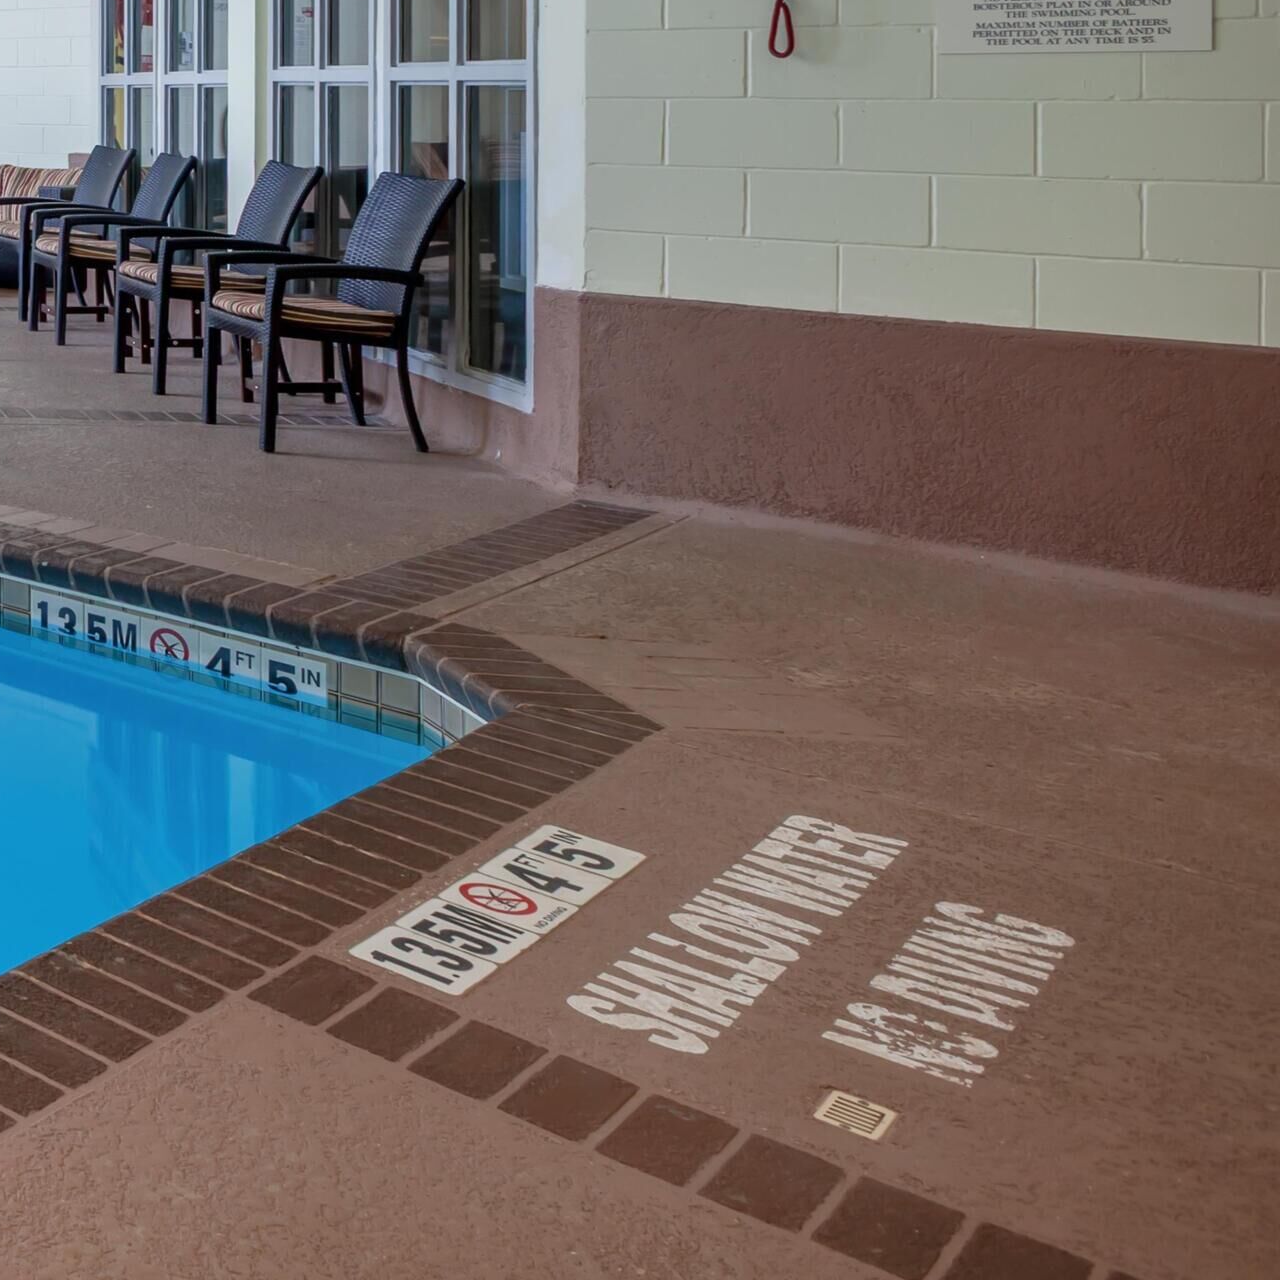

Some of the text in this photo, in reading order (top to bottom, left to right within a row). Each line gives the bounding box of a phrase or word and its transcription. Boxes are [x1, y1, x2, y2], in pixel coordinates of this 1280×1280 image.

[1046, 1, 1073, 9] PLAY
[1078, 0, 1091, 8] IN
[1031, 9, 1096, 18] SWIMMING
[1039, 20, 1090, 28] NUMBER
[1112, 18, 1168, 27] BATHERS
[972, 30, 1038, 38] PERMITTED
[1040, 29, 1059, 37] ON
[1061, 28, 1087, 36] THE
[1090, 28, 1122, 36] DECK
[1126, 27, 1154, 35] AND
[985, 38, 1009, 46] THE
[1065, 37, 1091, 45] ANY
[1094, 36, 1125, 44] TIME
[1128, 36, 1138, 44] IS
[534, 906, 568, 930] NO DIVING
[566, 815, 910, 1054] SHALLOW WATER
[821, 901, 1075, 1088] NO DIVING
